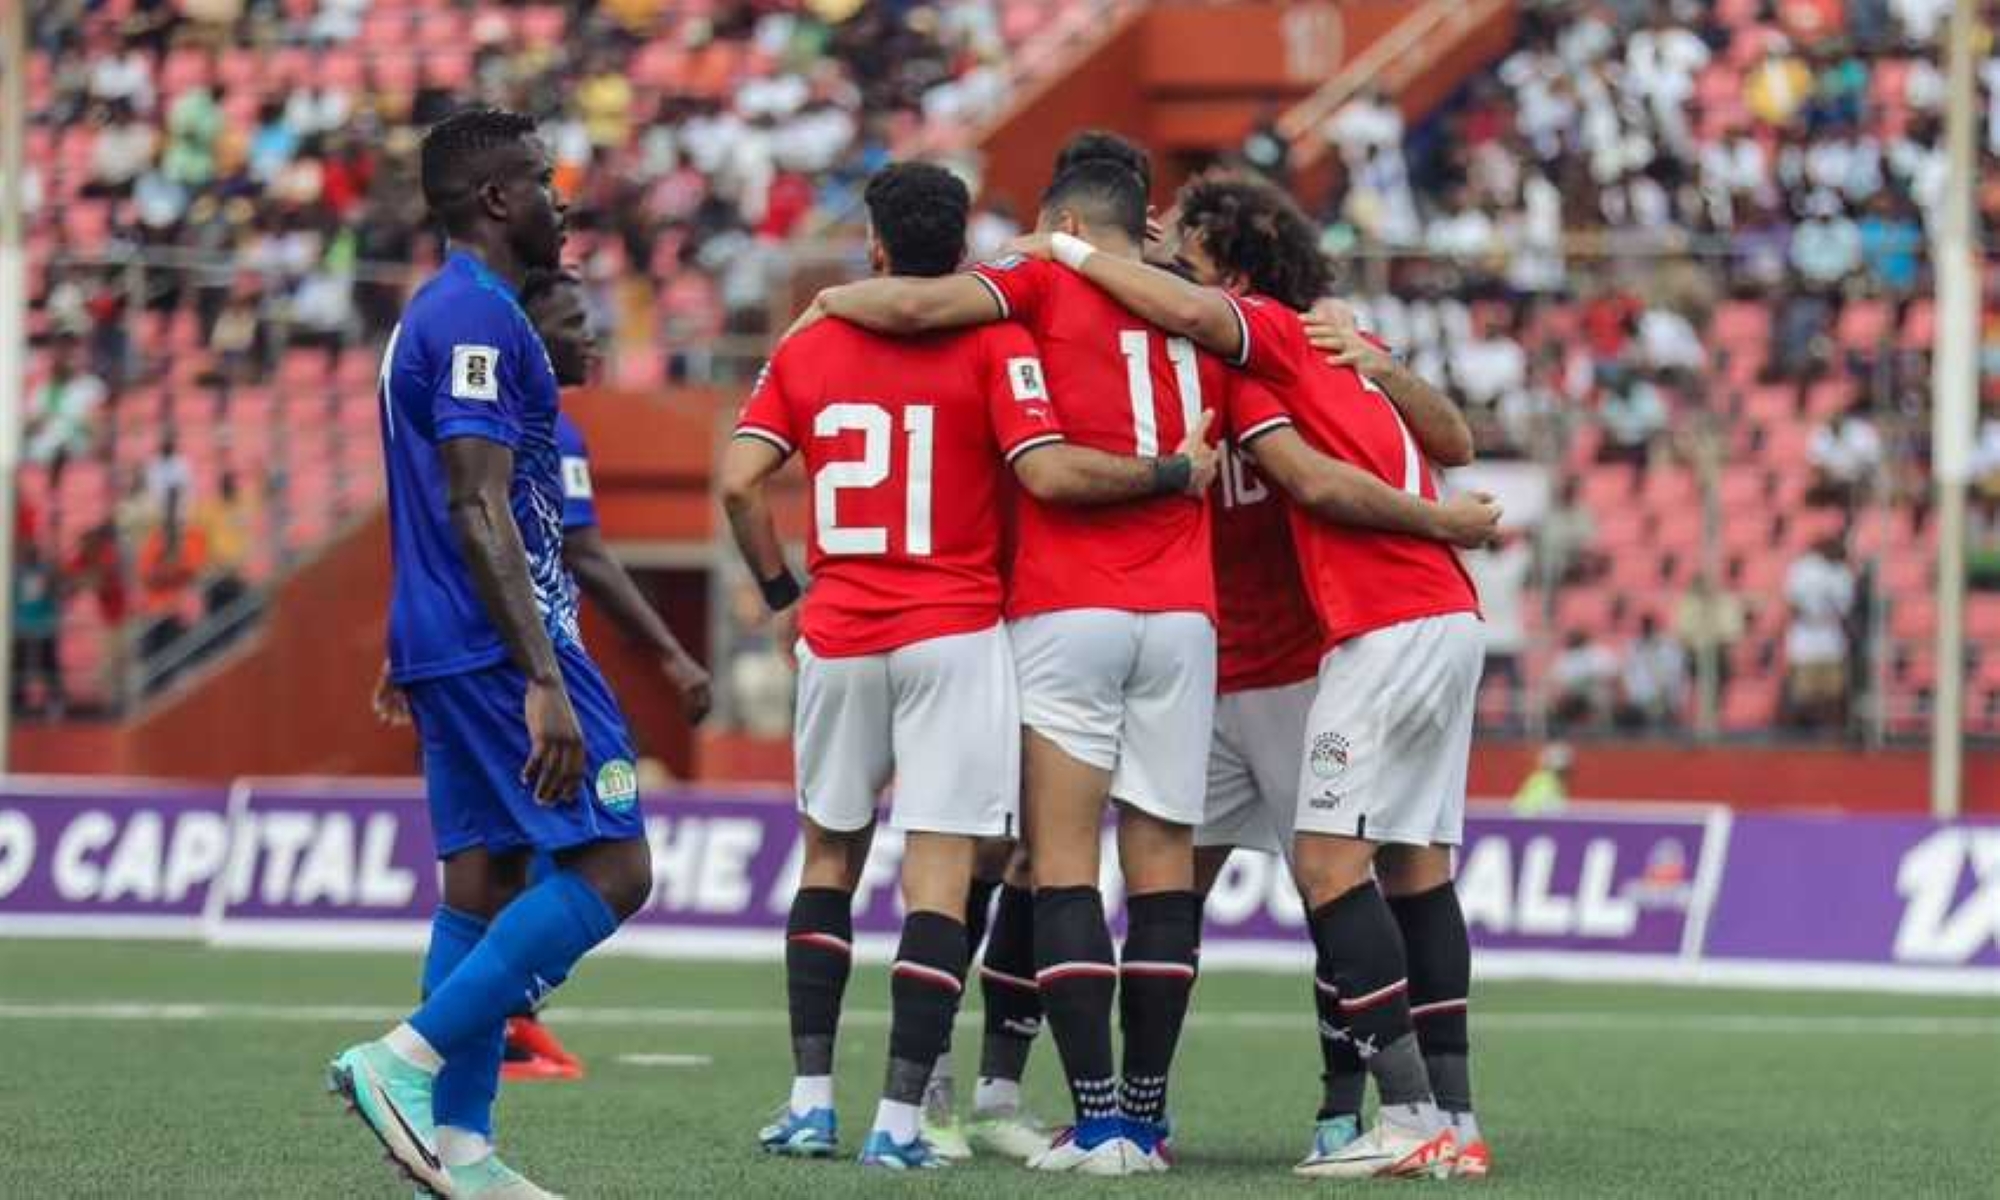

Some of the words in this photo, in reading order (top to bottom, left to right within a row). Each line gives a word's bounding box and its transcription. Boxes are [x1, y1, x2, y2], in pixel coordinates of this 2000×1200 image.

[1119, 330, 1202, 457] 11
[814, 404, 933, 556] 21
[52, 810, 415, 906] CAPITAL
[643, 816, 764, 914] HE
